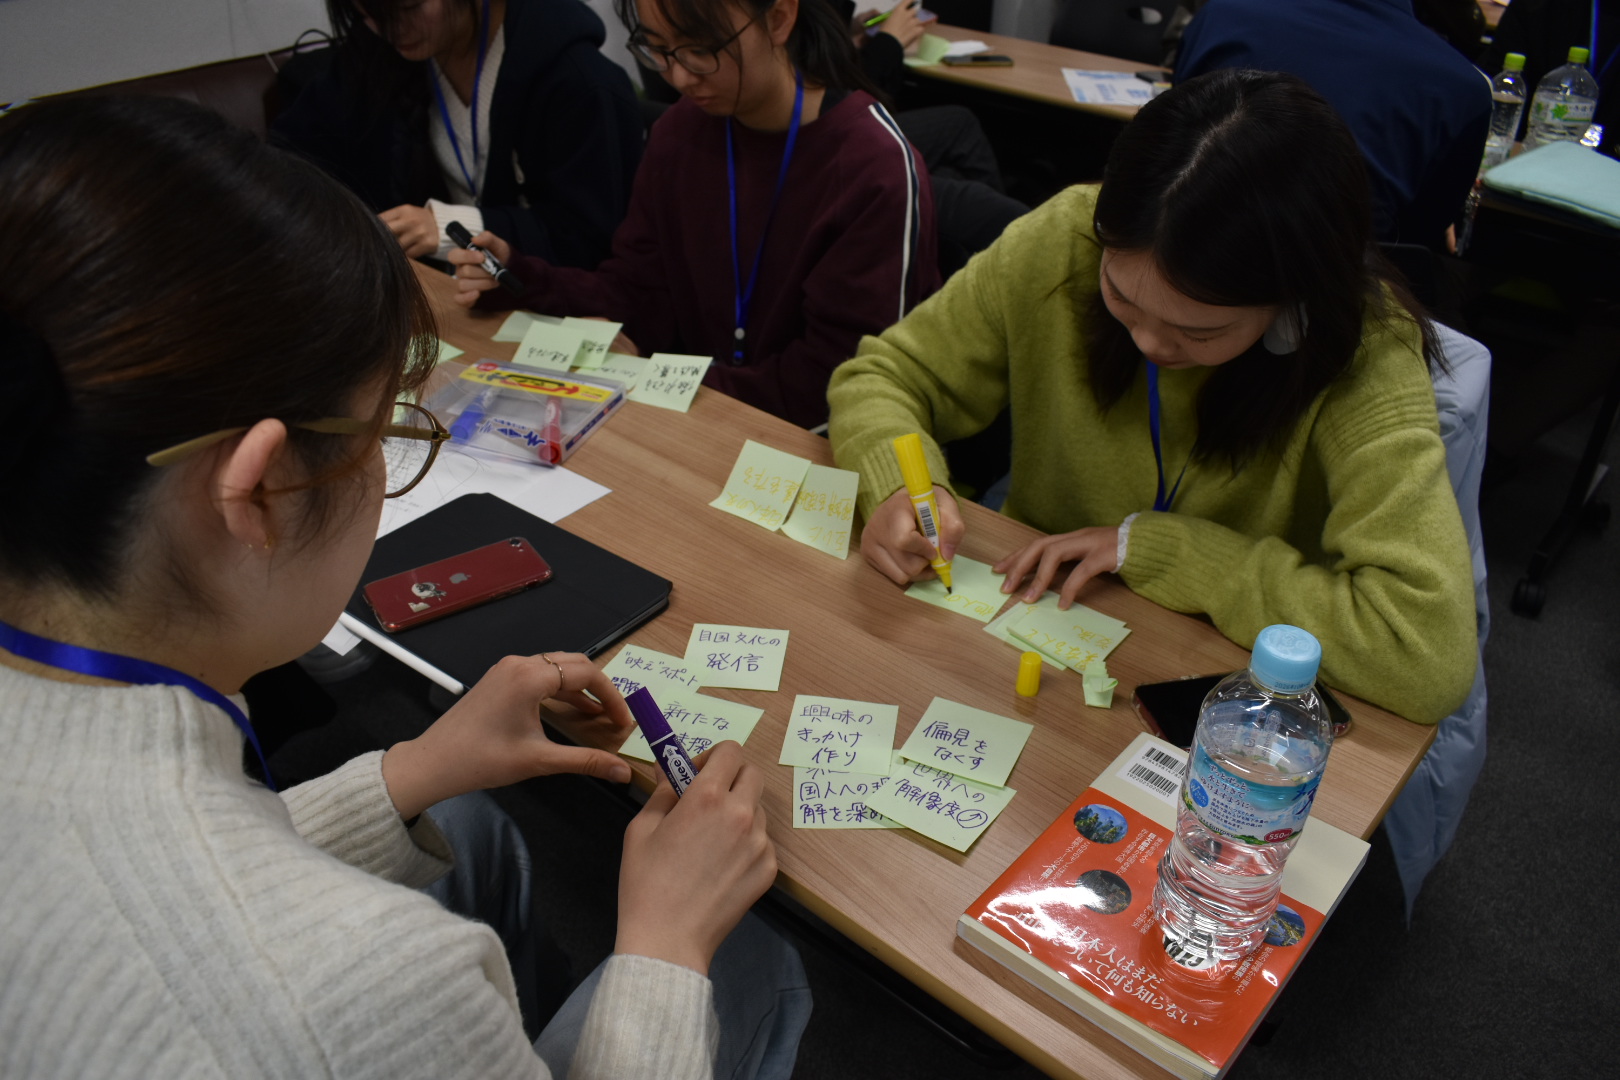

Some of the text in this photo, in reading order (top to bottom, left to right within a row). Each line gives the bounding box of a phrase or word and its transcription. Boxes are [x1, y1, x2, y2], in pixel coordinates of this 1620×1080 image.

[706, 652, 764, 672] 発信
[663, 700, 730, 731] 新たな
[800, 704, 873, 725] 興味の
[797, 727, 863, 748] きっかけ
[923, 720, 988, 755] 偏見を
[812, 747, 857, 766] 作り
[933, 745, 985, 770] なくす
